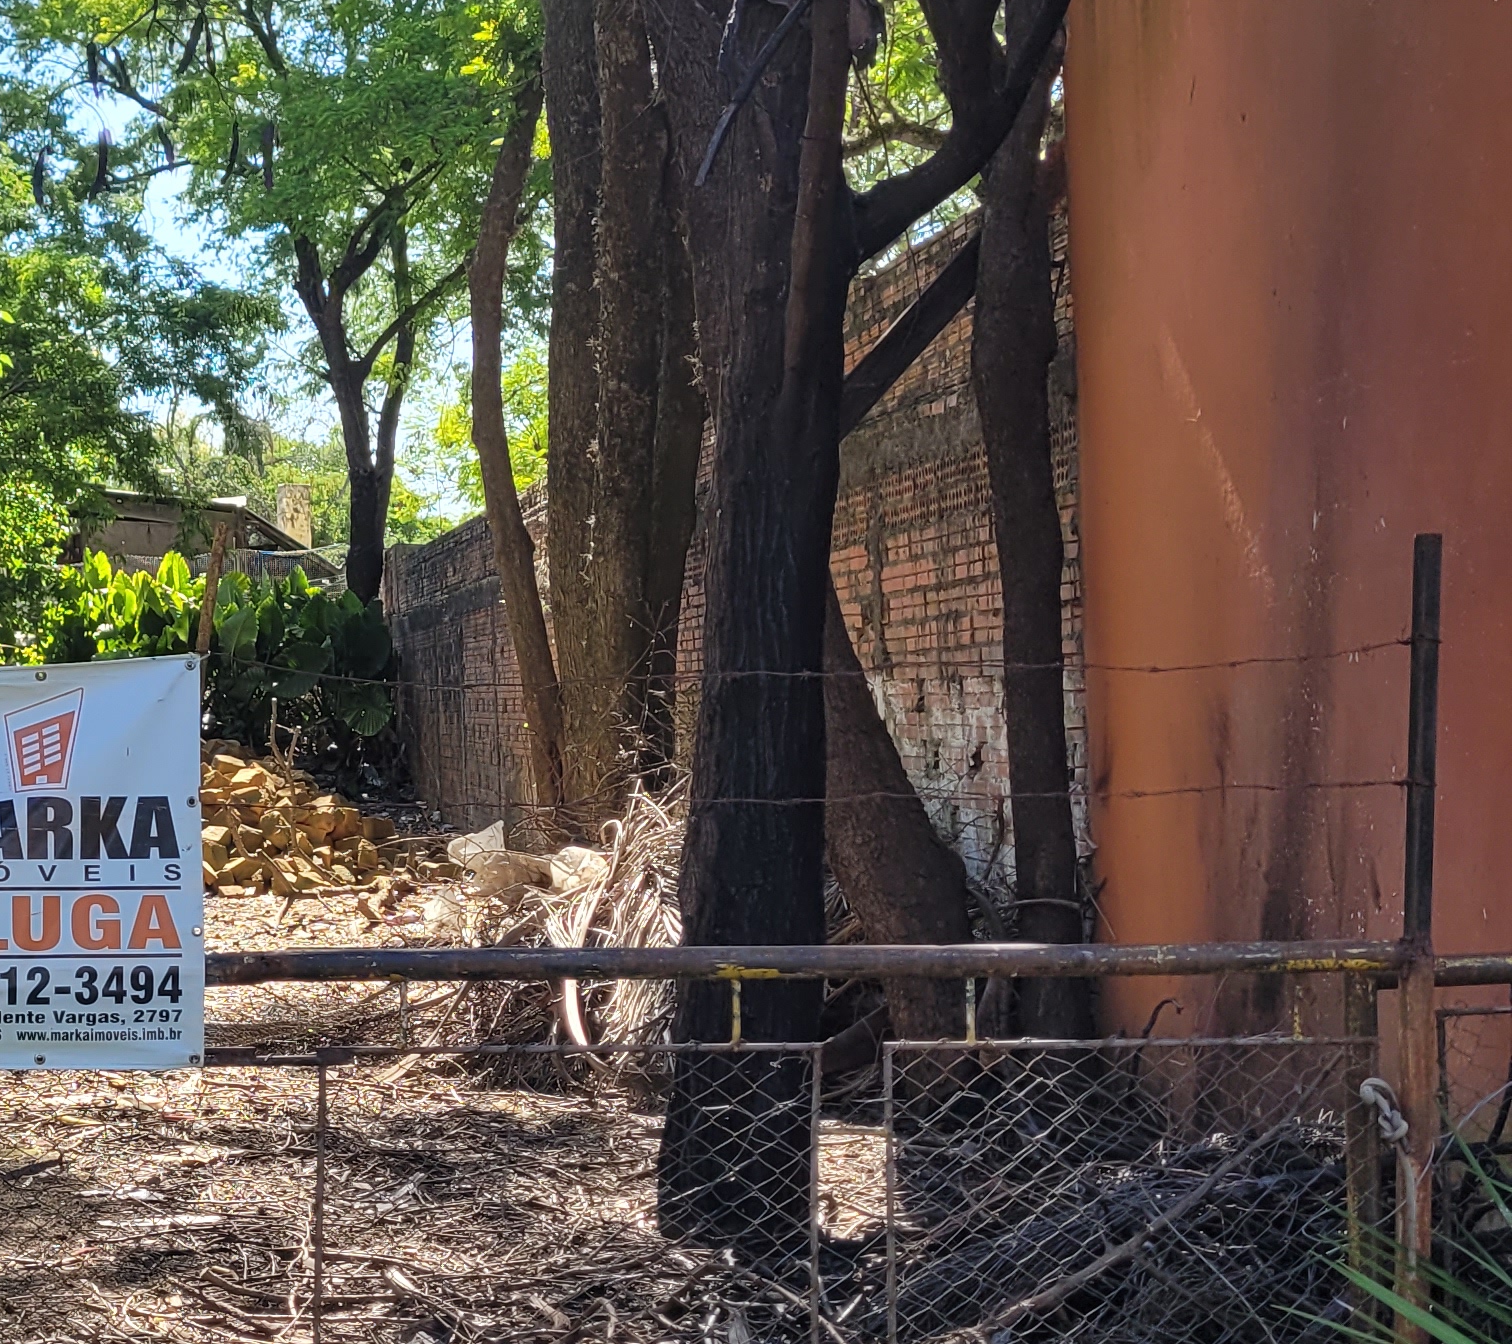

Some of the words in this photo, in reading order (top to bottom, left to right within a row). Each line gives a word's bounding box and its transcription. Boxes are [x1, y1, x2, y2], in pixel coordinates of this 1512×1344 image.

[52, 1009, 126, 1026] Vargas,
[132, 1009, 183, 1023] 2797
[16, 1027, 183, 1043] www.markaimoveis.imb.br
